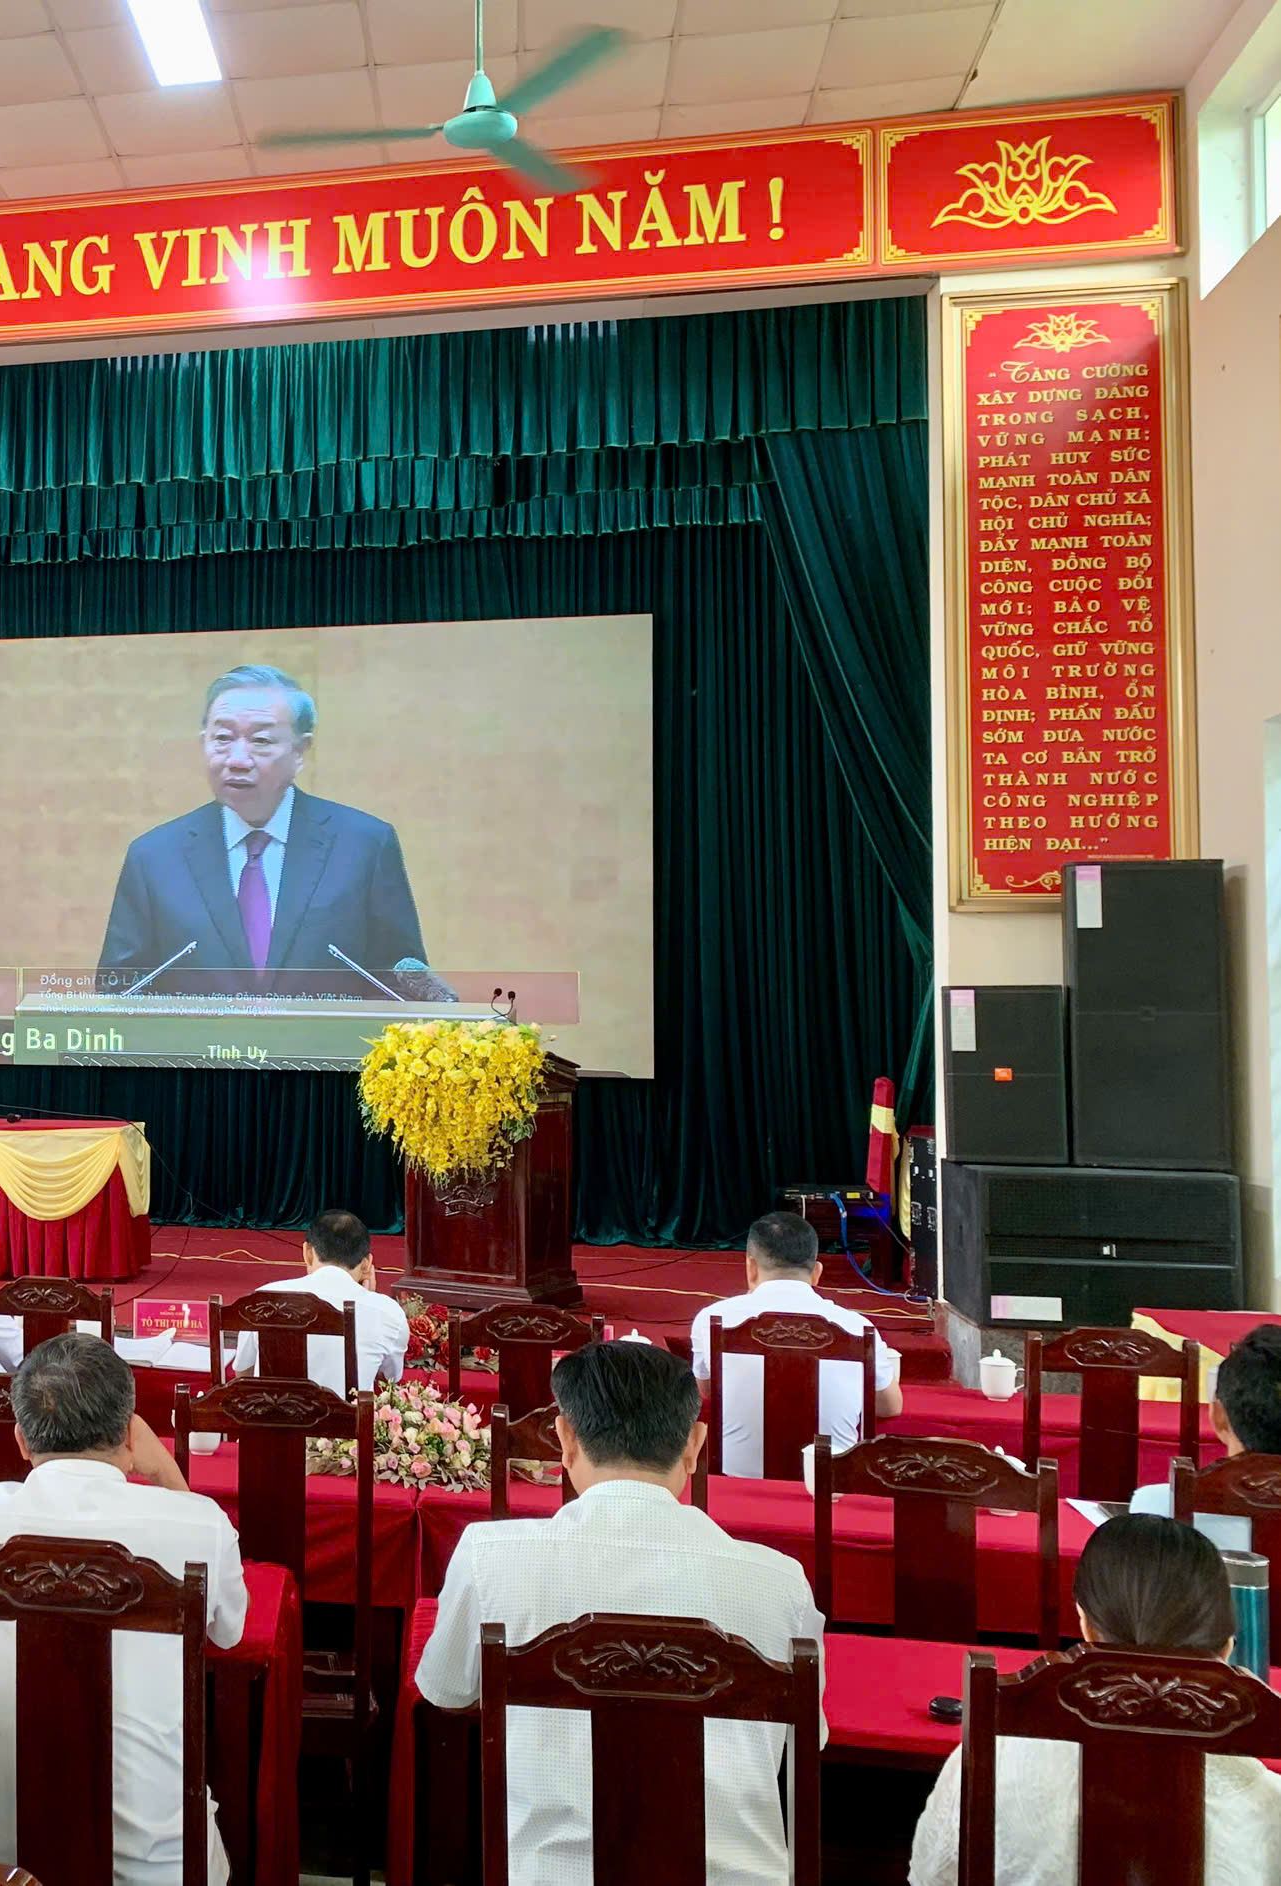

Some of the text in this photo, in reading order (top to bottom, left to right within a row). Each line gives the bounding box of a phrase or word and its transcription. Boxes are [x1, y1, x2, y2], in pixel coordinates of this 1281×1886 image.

[133, 217, 312, 290] VINH
[332, 186, 554, 275] MUÔN
[1082, 363, 1149, 379] CƯỜNG
[976, 382, 1149, 405] XÂY DỰNG ĐẢNG
[977, 411, 1054, 426] TRONG
[977, 432, 1045, 447] VỮNG
[978, 446, 1151, 468] PHÁT HUY SỨC
[978, 468, 1151, 490] MẠNH TOÀN DÂN
[1030, 492, 1070, 508] DÂN
[1076, 489, 1117, 506] CHỦ
[1124, 489, 1152, 504] XÃ
[979, 516, 1014, 533] HỘI
[1028, 512, 1068, 529] CHỦ
[979, 532, 1152, 552] ĐẨY MẠNH TOÀN
[1052, 552, 1107, 571] ĐỒNG
[1126, 553, 1152, 570] BỘ
[980, 571, 1153, 594] CÔNG CUỘC ĐỔI
[1054, 596, 1101, 613] BẢO
[1122, 596, 1151, 613] VỆ
[980, 613, 1153, 636] VỮNG CHẮC TỔ
[1053, 641, 1088, 656] GIỮ
[1100, 640, 1155, 655] VỮNG
[981, 661, 1155, 680] MÔI TRƯỜNG
[981, 686, 1027, 701] HÒA
[1125, 680, 1155, 698] ỔN
[1049, 702, 1102, 721] PHẤN
[1114, 702, 1156, 720] ĐẤU
[982, 726, 1157, 743] SỚM ĐƯA NƯỚC
[983, 746, 1157, 764] TA CƠ BẢN TRỞ
[983, 770, 1158, 786] THÀNH NƯỚC
[983, 791, 1159, 808] CÔNG NGHIỆP
[983, 812, 1159, 828] THEO HƯỚNG
[984, 836, 1032, 853] HIỆN
[26, 1028, 56, 1049] Ba
[67, 1028, 124, 1051] Dinh
